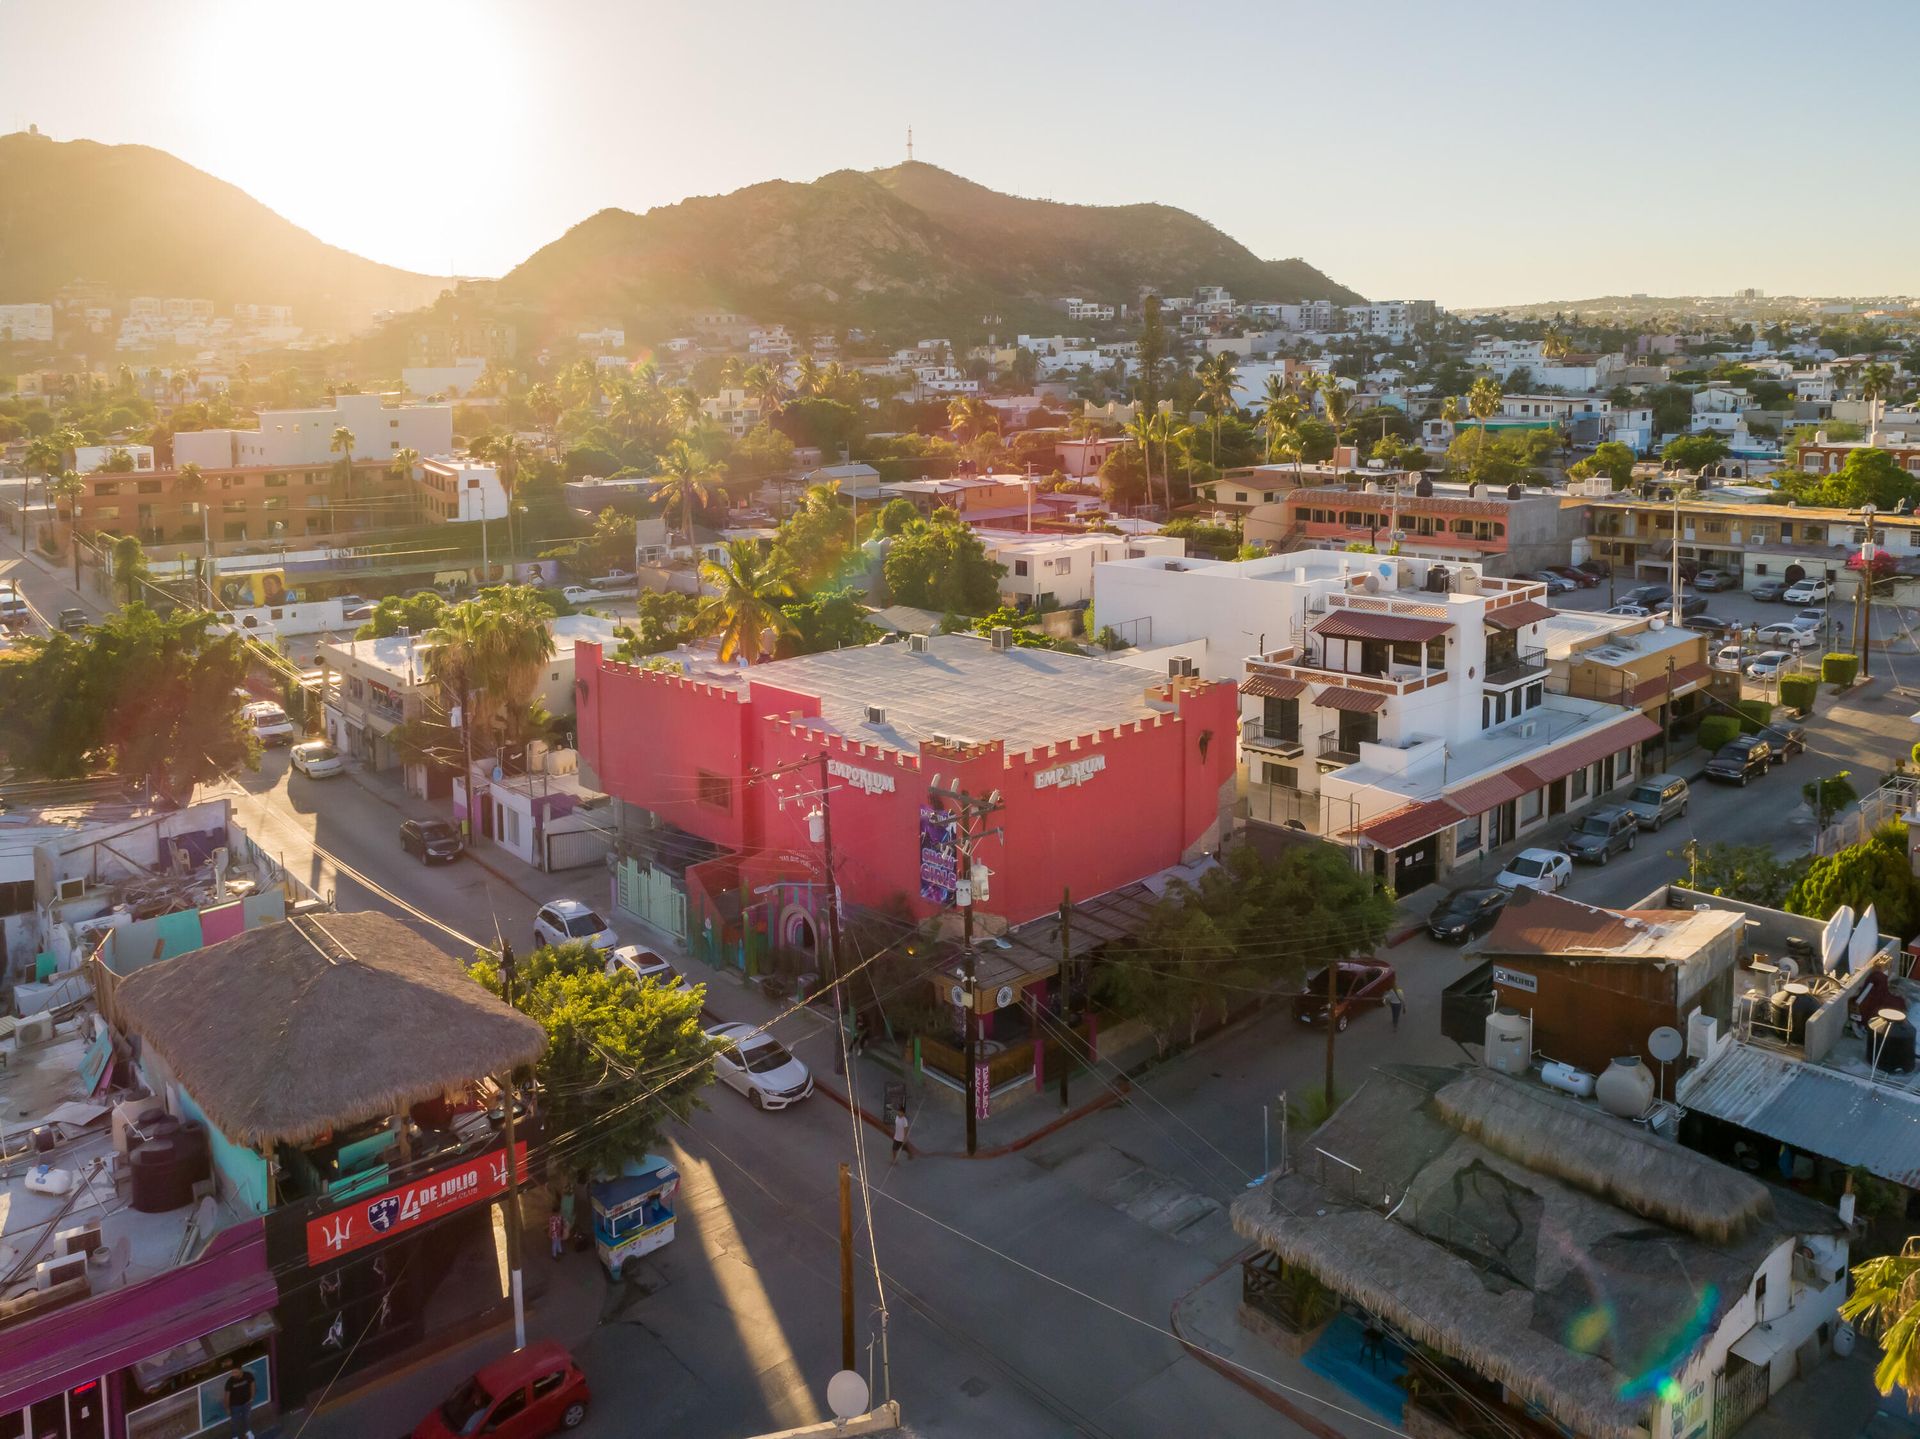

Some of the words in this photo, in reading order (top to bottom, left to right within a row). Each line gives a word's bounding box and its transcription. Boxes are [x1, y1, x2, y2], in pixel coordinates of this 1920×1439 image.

[827, 760, 895, 794] EMPORIUM
[1035, 755, 1106, 789] EMPORIUM
[921, 863, 957, 891] GIRLS
[400, 1189, 420, 1220] 4
[420, 1185, 438, 1207] DE
[441, 1170, 478, 1198] JULIO
